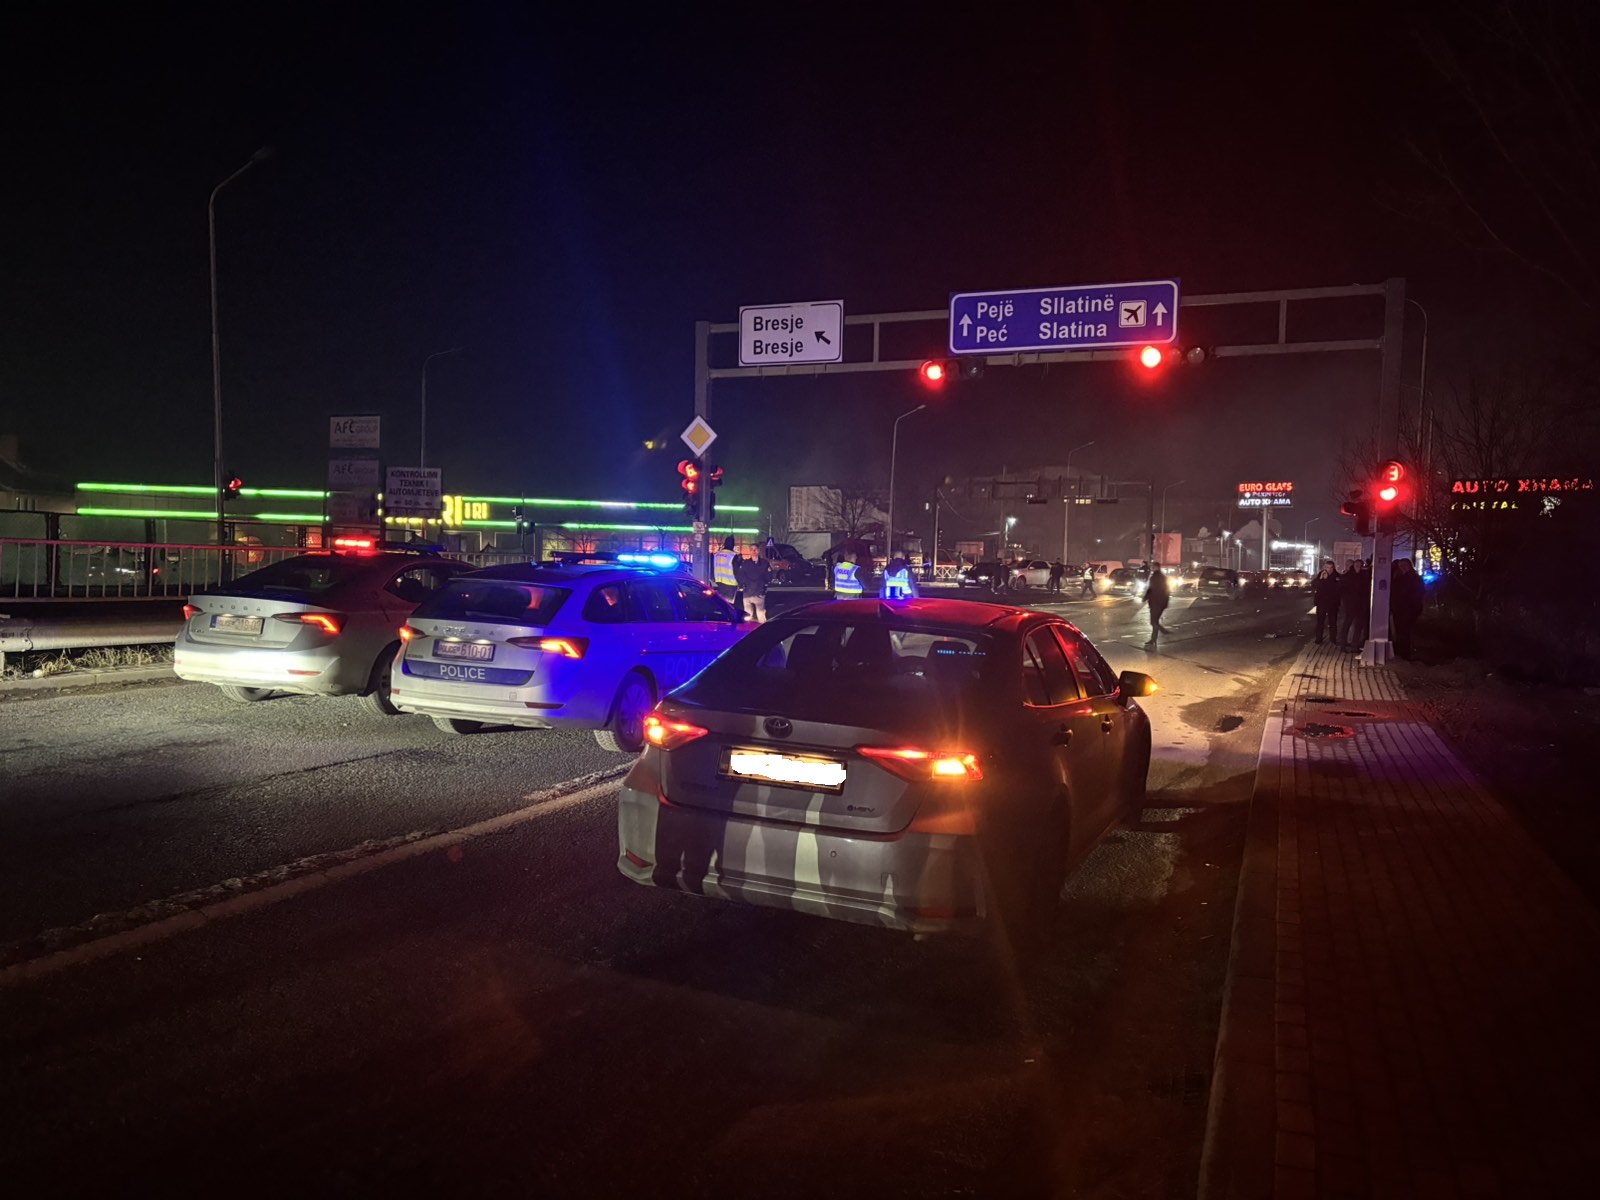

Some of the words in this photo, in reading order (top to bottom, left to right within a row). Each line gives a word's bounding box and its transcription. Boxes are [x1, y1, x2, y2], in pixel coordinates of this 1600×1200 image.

[976, 299, 1014, 322] Pejë
[1039, 293, 1115, 317] Sllatinë
[753, 314, 804, 334] Bresje
[976, 324, 1009, 344] Peć
[1038, 321, 1108, 341] Slatina
[753, 337, 804, 357] Bresje
[1239, 483, 1264, 492] EURO
[1239, 498, 1262, 506] AUTO
[460, 644, 492, 659] 610-01
[439, 664, 487, 681] POLICE
